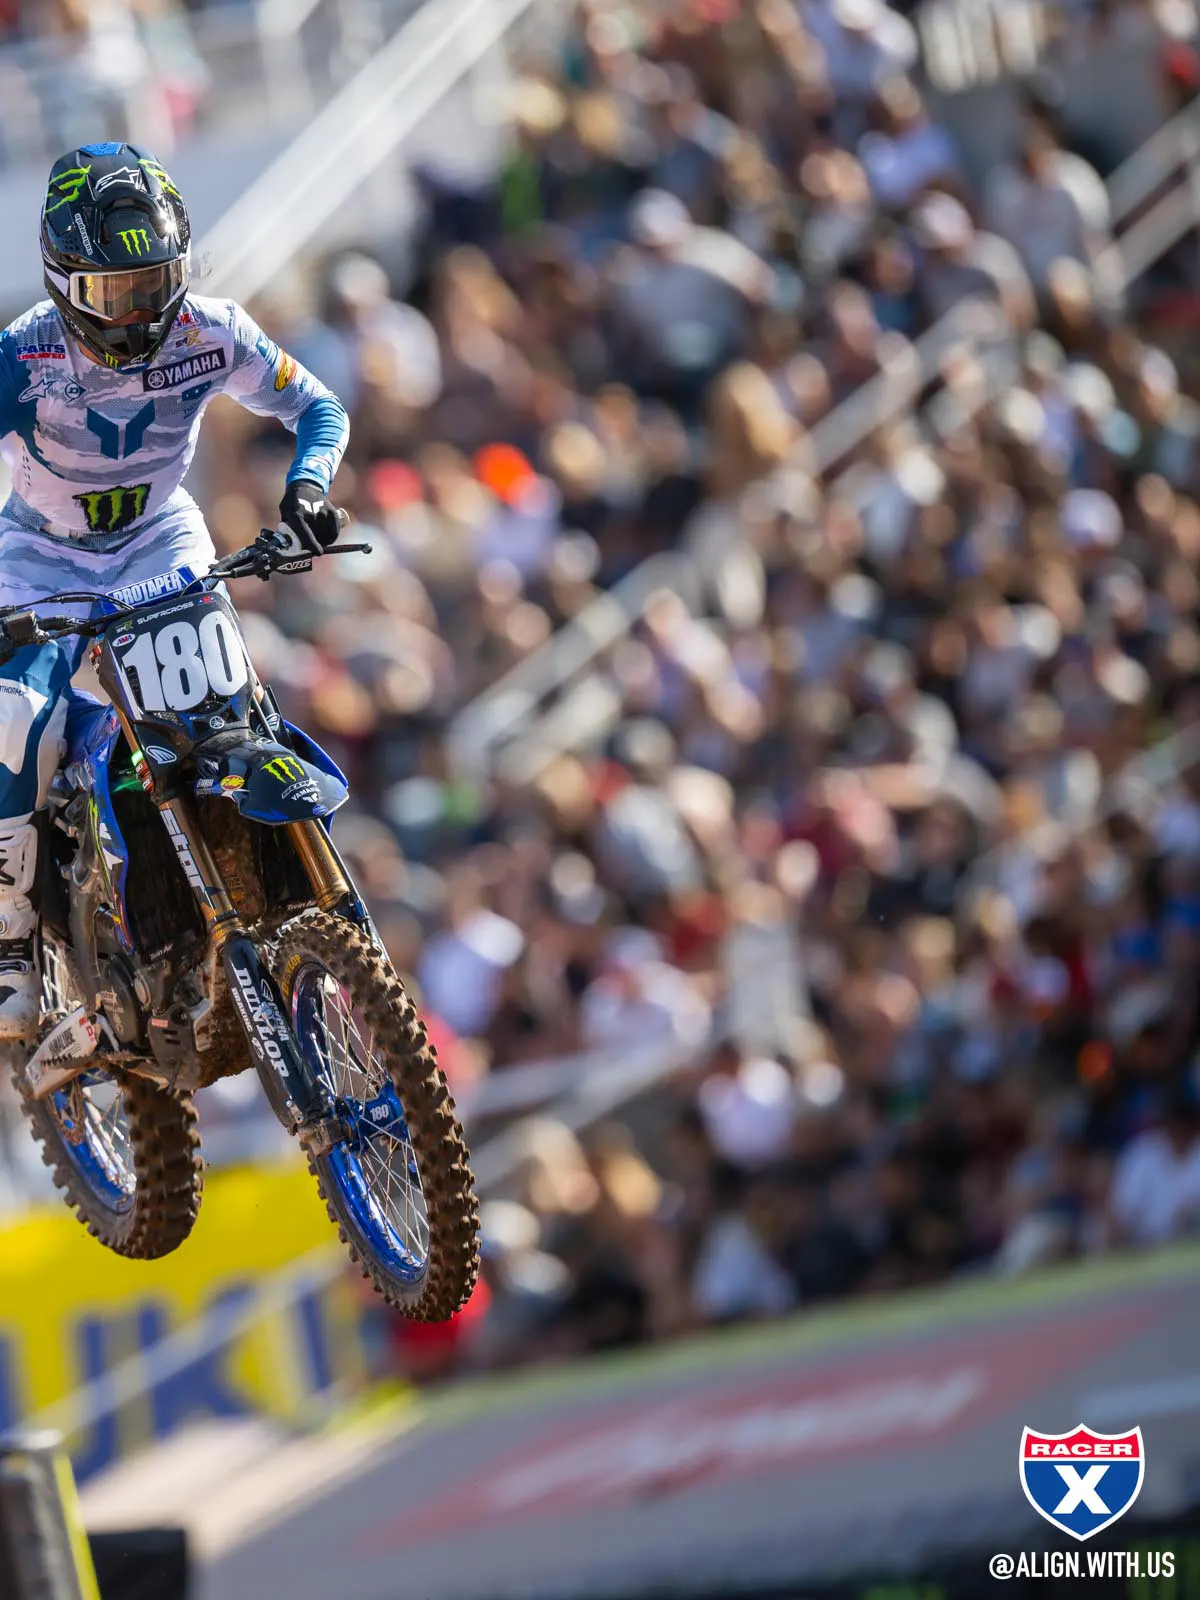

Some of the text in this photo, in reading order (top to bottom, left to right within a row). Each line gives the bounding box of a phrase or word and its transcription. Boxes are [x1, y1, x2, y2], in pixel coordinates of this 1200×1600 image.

[16, 344, 65, 355] PARTS
[164, 353, 221, 385] YAMAHA
[113, 572, 181, 605] PROTAPER
[137, 601, 194, 625] SUPERCROSS
[121, 610, 247, 711] 180
[291, 787, 322, 801] YAMAHA
[233, 967, 290, 1078] DUNLOP
[370, 1104, 389, 1122] 180
